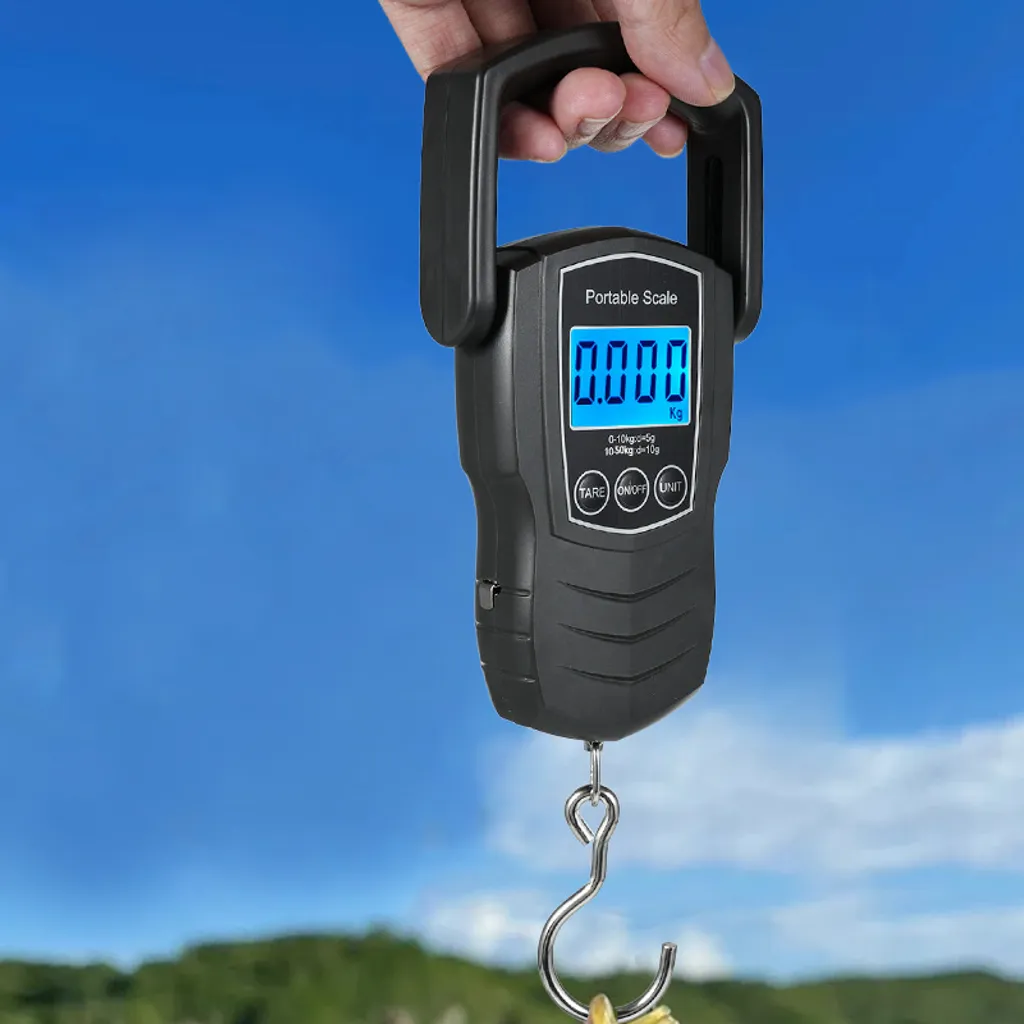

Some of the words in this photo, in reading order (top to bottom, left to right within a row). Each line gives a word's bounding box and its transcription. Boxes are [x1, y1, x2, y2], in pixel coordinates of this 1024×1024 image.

[585, 289, 639, 305] Portable
[643, 290, 678, 305] Scale
[574, 340, 687, 405] 0.000
[669, 406, 683, 421] Kg
[579, 487, 606, 499] TARE
[617, 484, 647, 496] ON/OFF
[660, 481, 683, 493] UNIT
